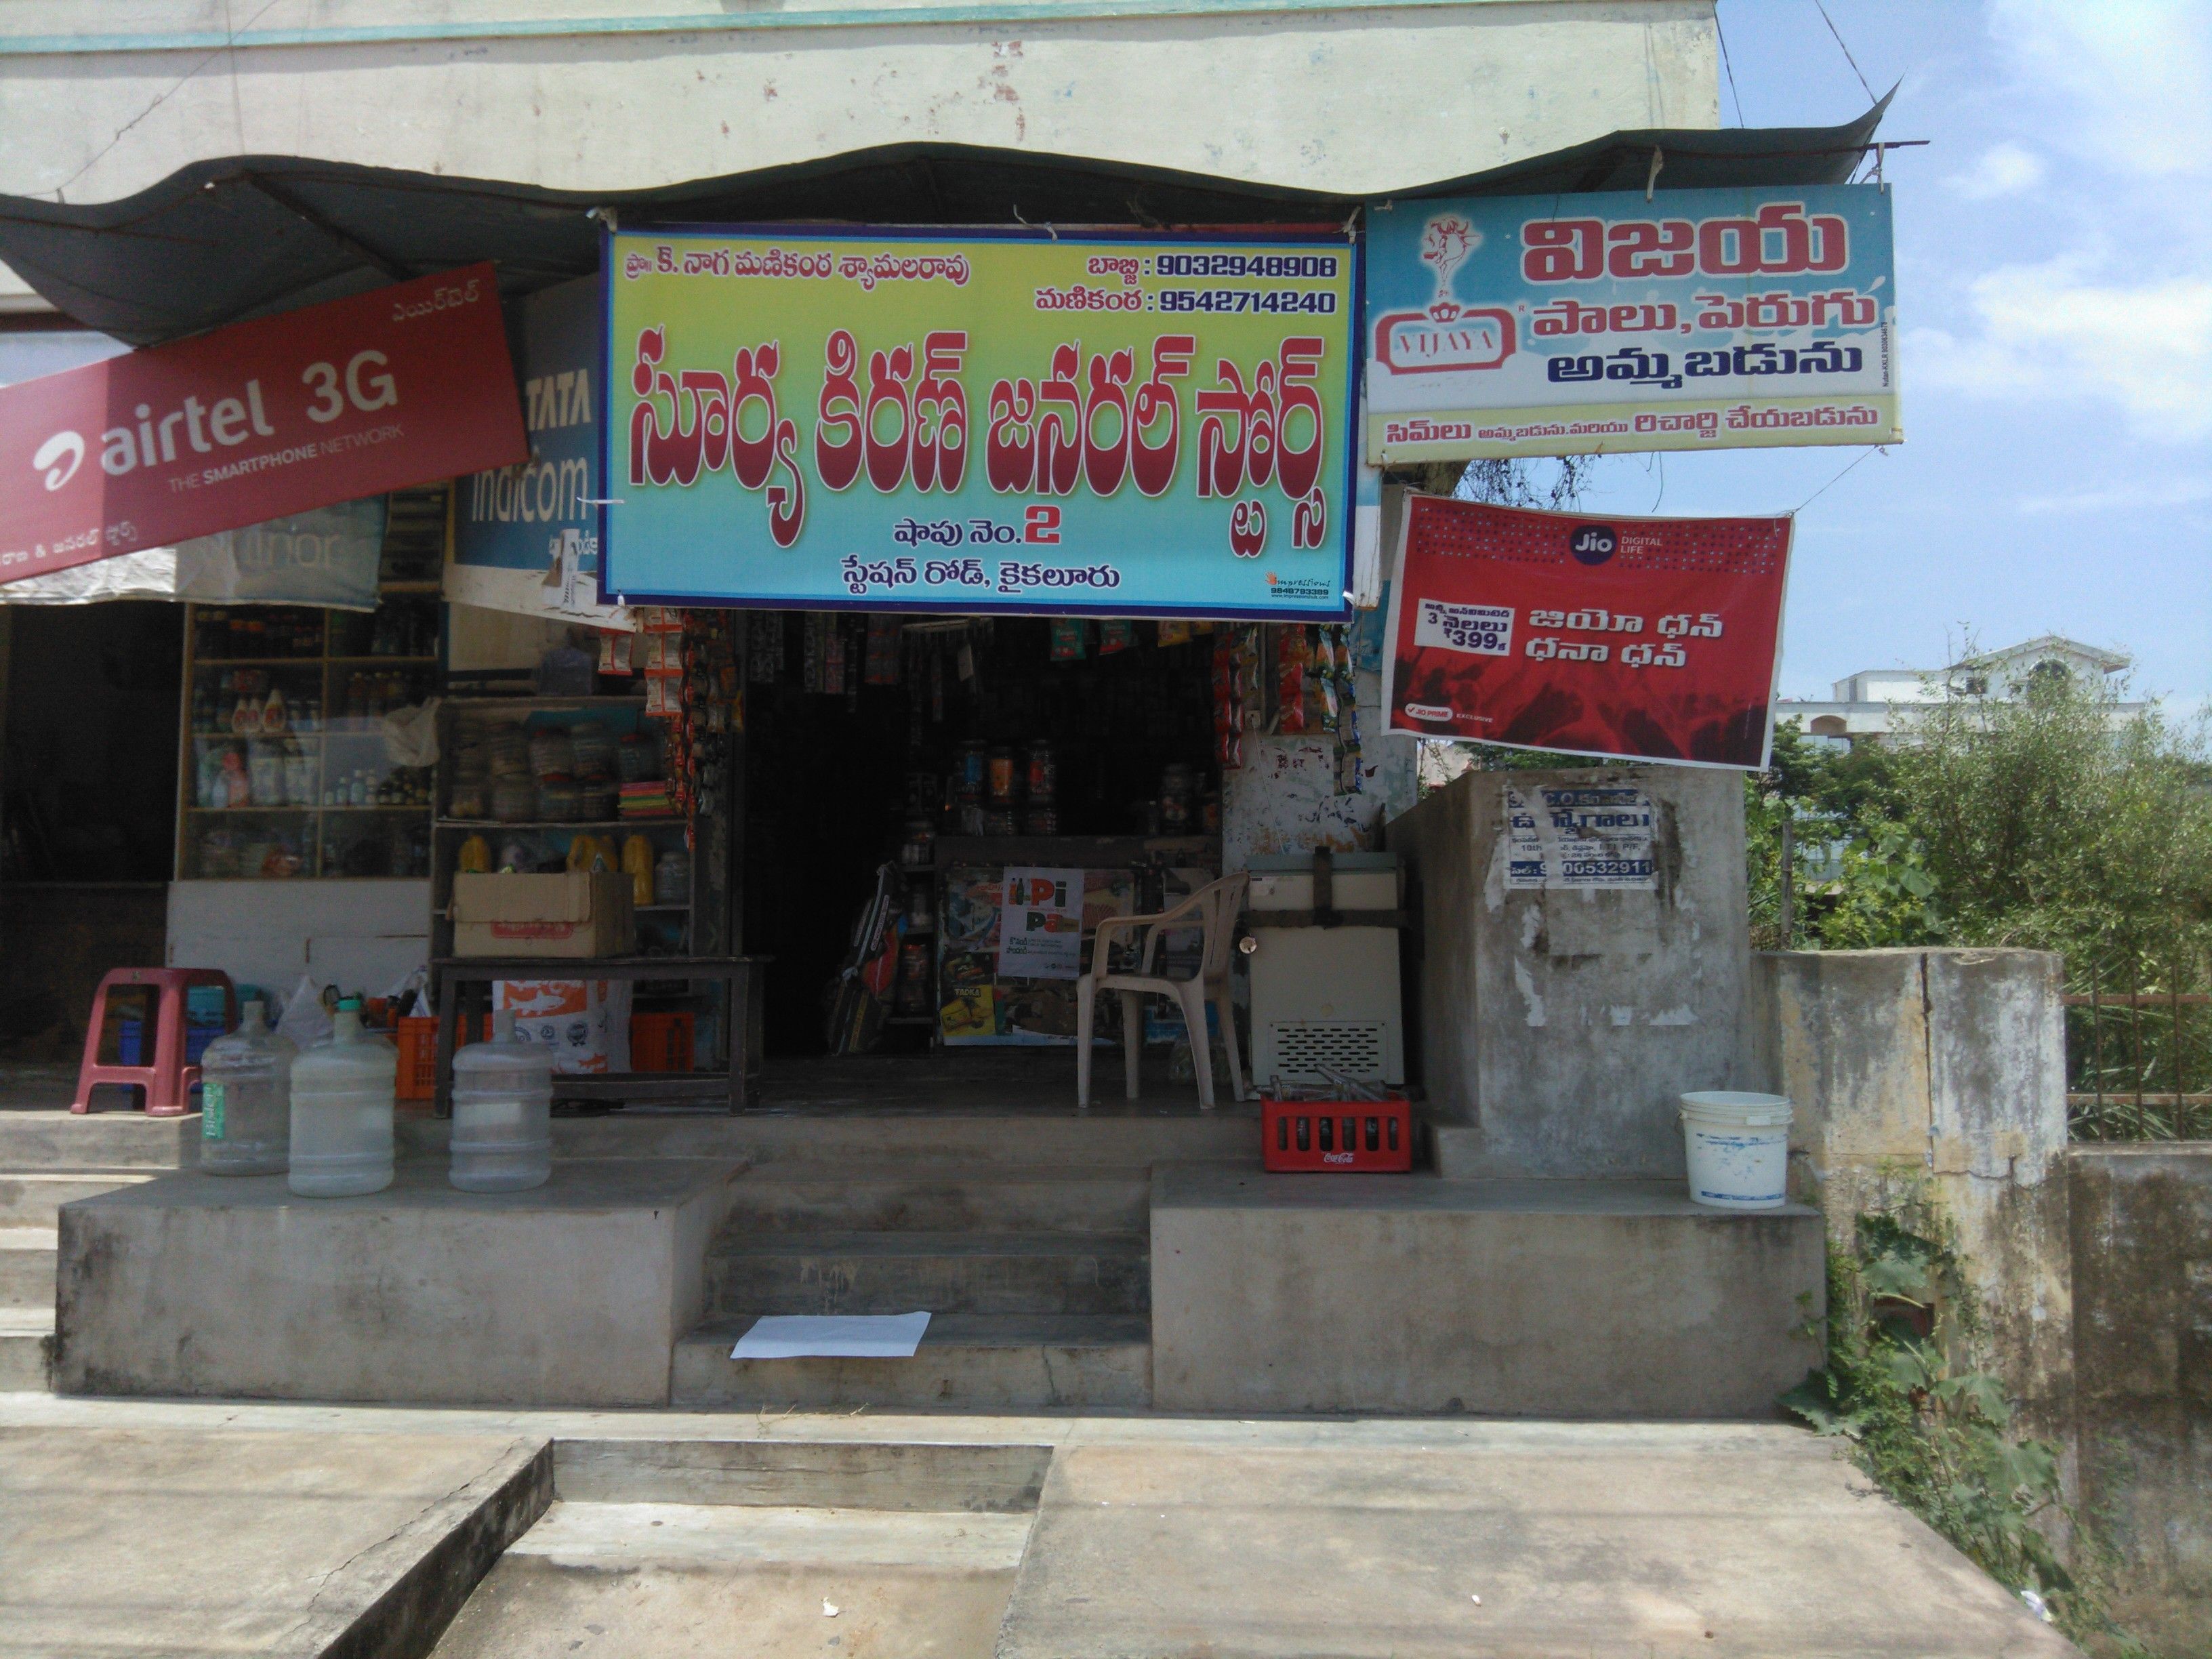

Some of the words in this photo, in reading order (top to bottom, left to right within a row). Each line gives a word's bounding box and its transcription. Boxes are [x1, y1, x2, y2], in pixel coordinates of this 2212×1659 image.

[1523, 202, 1846, 282] విజయ
[684, 249, 730, 275] నాగ
[735, 249, 832, 277] మణికంఠ
[1156, 255, 1337, 276] 9032948908
[1160, 291, 1336, 314] 9542714240
[1696, 293, 1876, 329] పెరుగు
[1399, 330, 1494, 354] VIJAYA
[1547, 340, 1863, 389] అమ్మబడును
[101, 380, 274, 476] airtel
[302, 349, 398, 424] 3G
[526, 368, 592, 431] TATA
[630, 325, 805, 548] సూర్య
[815, 329, 968, 493] కిరణ్
[985, 335, 1195, 497] జనరల్
[1196, 336, 1327, 558] స్టోర్స్
[169, 474, 201, 493] THE
[202, 442, 318, 485] SMARTPHONE
[319, 423, 405, 456] NETWORK
[894, 518, 962, 548] షాపు
[1575, 532, 1613, 552] Jio
[1621, 535, 1663, 547] DIGITAL
[1620, 545, 1644, 554] LIFE
[841, 554, 917, 594] స్టేషన్
[998, 560, 1120, 594] కైకలూరు
[1427, 612, 1437, 624] 3
[1443, 615, 1508, 632] నెలలు
[1528, 608, 1643, 634] జియో
[1456, 713, 1494, 723] EXCLUSIVE
